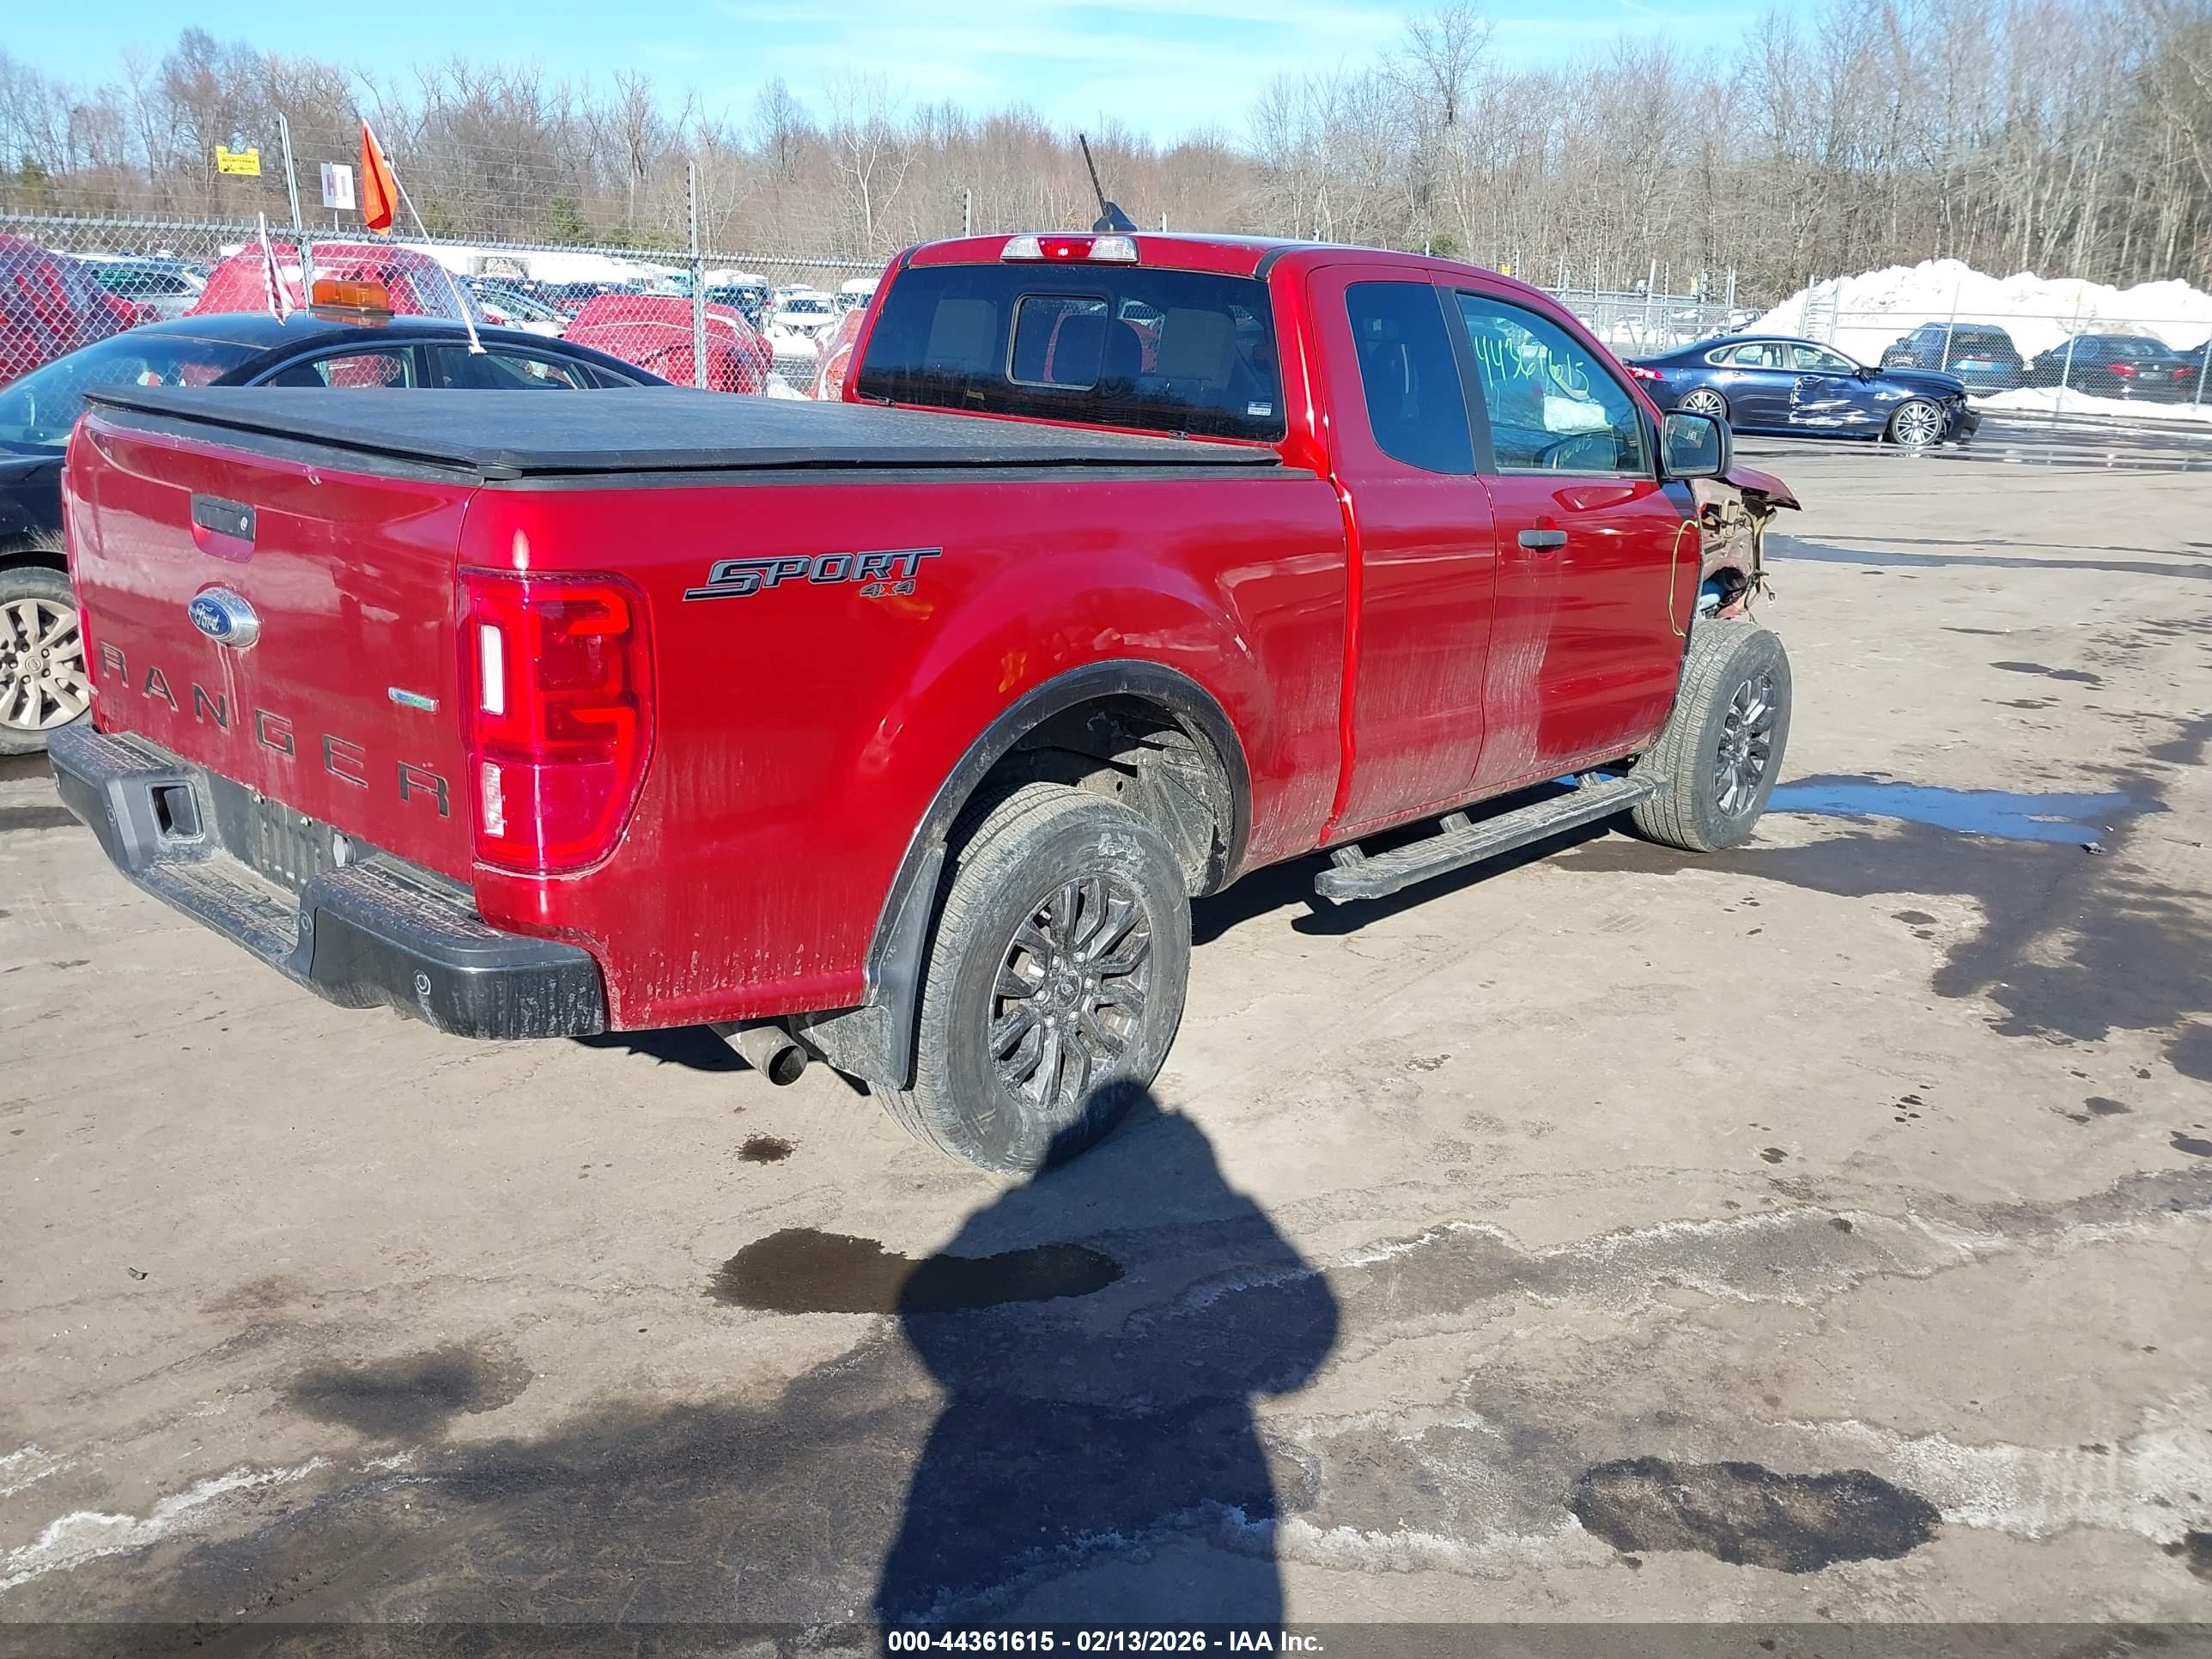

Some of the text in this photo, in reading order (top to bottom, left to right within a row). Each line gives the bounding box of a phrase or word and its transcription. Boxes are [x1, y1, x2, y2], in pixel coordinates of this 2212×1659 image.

[683, 547, 943, 601] SPORT
[193, 601, 221, 632] Ford
[100, 641, 450, 818] RANGER
